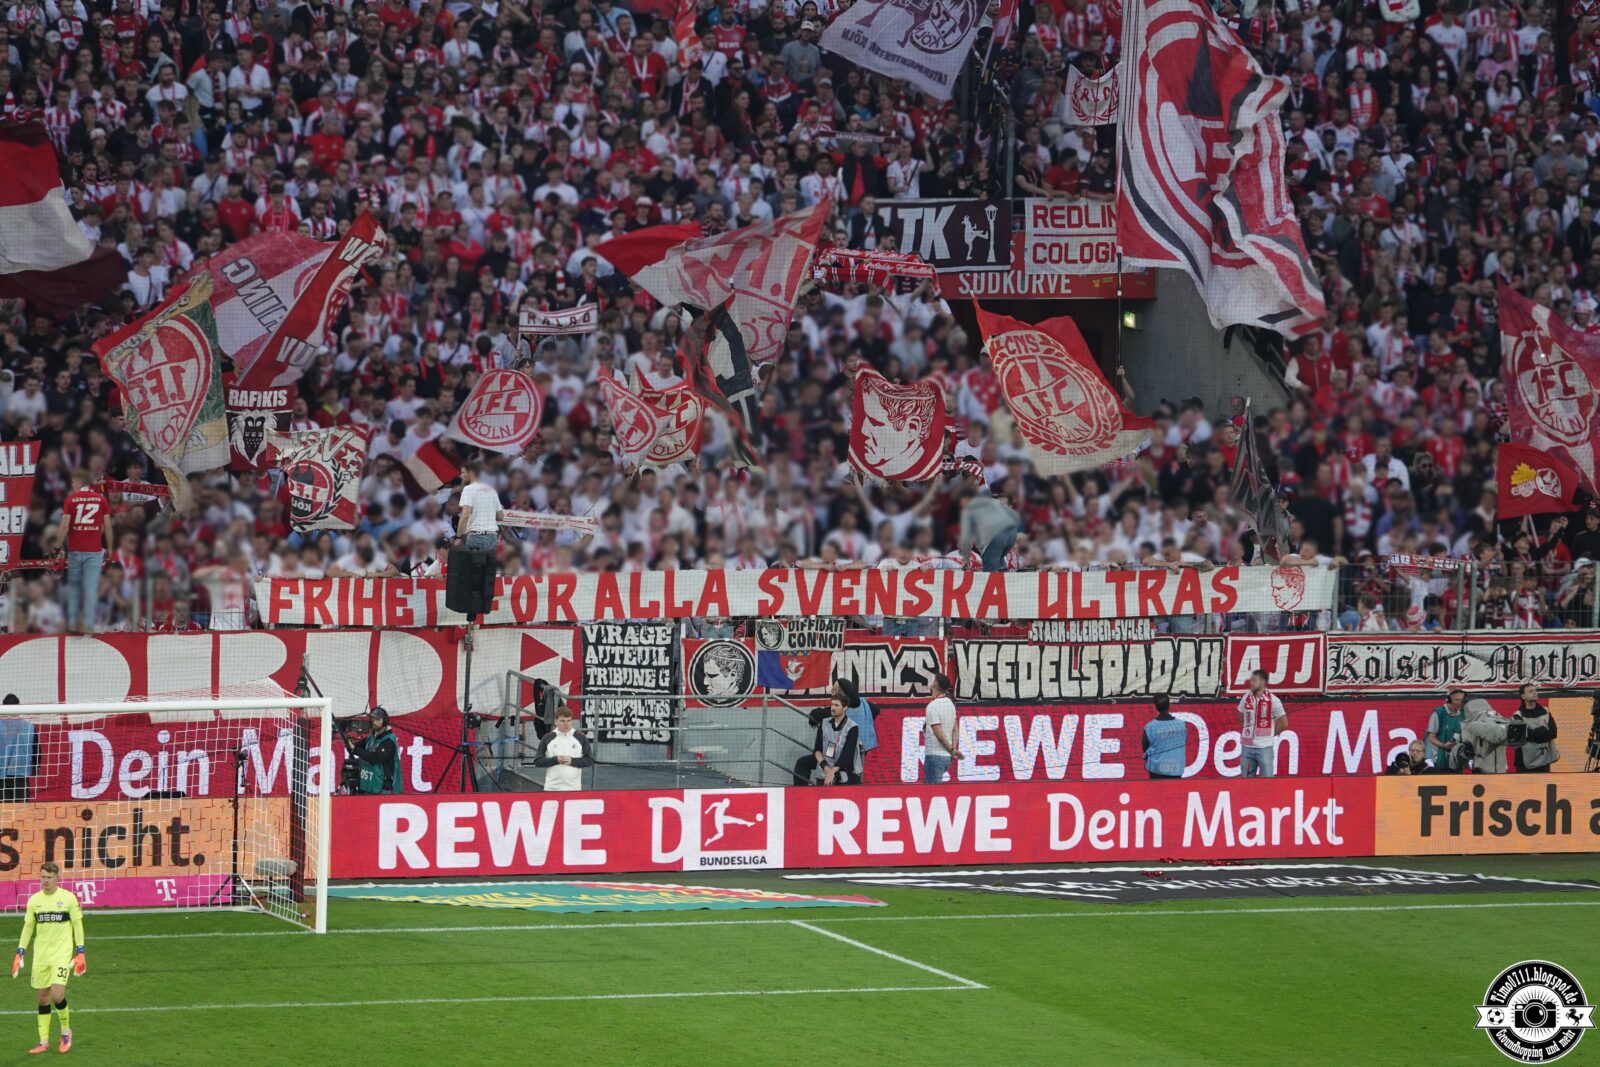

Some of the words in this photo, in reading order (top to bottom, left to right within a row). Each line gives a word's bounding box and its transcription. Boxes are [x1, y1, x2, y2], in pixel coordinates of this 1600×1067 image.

[228, 389, 288, 408] RAFIKIS
[74, 503, 100, 525] 12
[269, 577, 446, 626] FRIHET
[593, 567, 730, 620] ALLA
[757, 566, 1009, 618] SVENSKA
[1037, 566, 1240, 619] ULTRAS
[583, 624, 672, 645] VIRAGE
[585, 645, 670, 667] AUTEUIL
[586, 666, 657, 688] TRIBUNE
[659, 667, 671, 688] G
[1234, 643, 1316, 686] AJJ
[1328, 643, 1474, 689] Kölsche
[68, 729, 210, 799] Dein
[818, 795, 1012, 855] REWE
[1047, 792, 1162, 851] Dein
[1181, 789, 1344, 848] Markt
[1418, 783, 1572, 837] Frisch
[44, 807, 206, 869] nicht.
[378, 798, 607, 870] REWE
[699, 854, 768, 867] BUNDESLIGA
